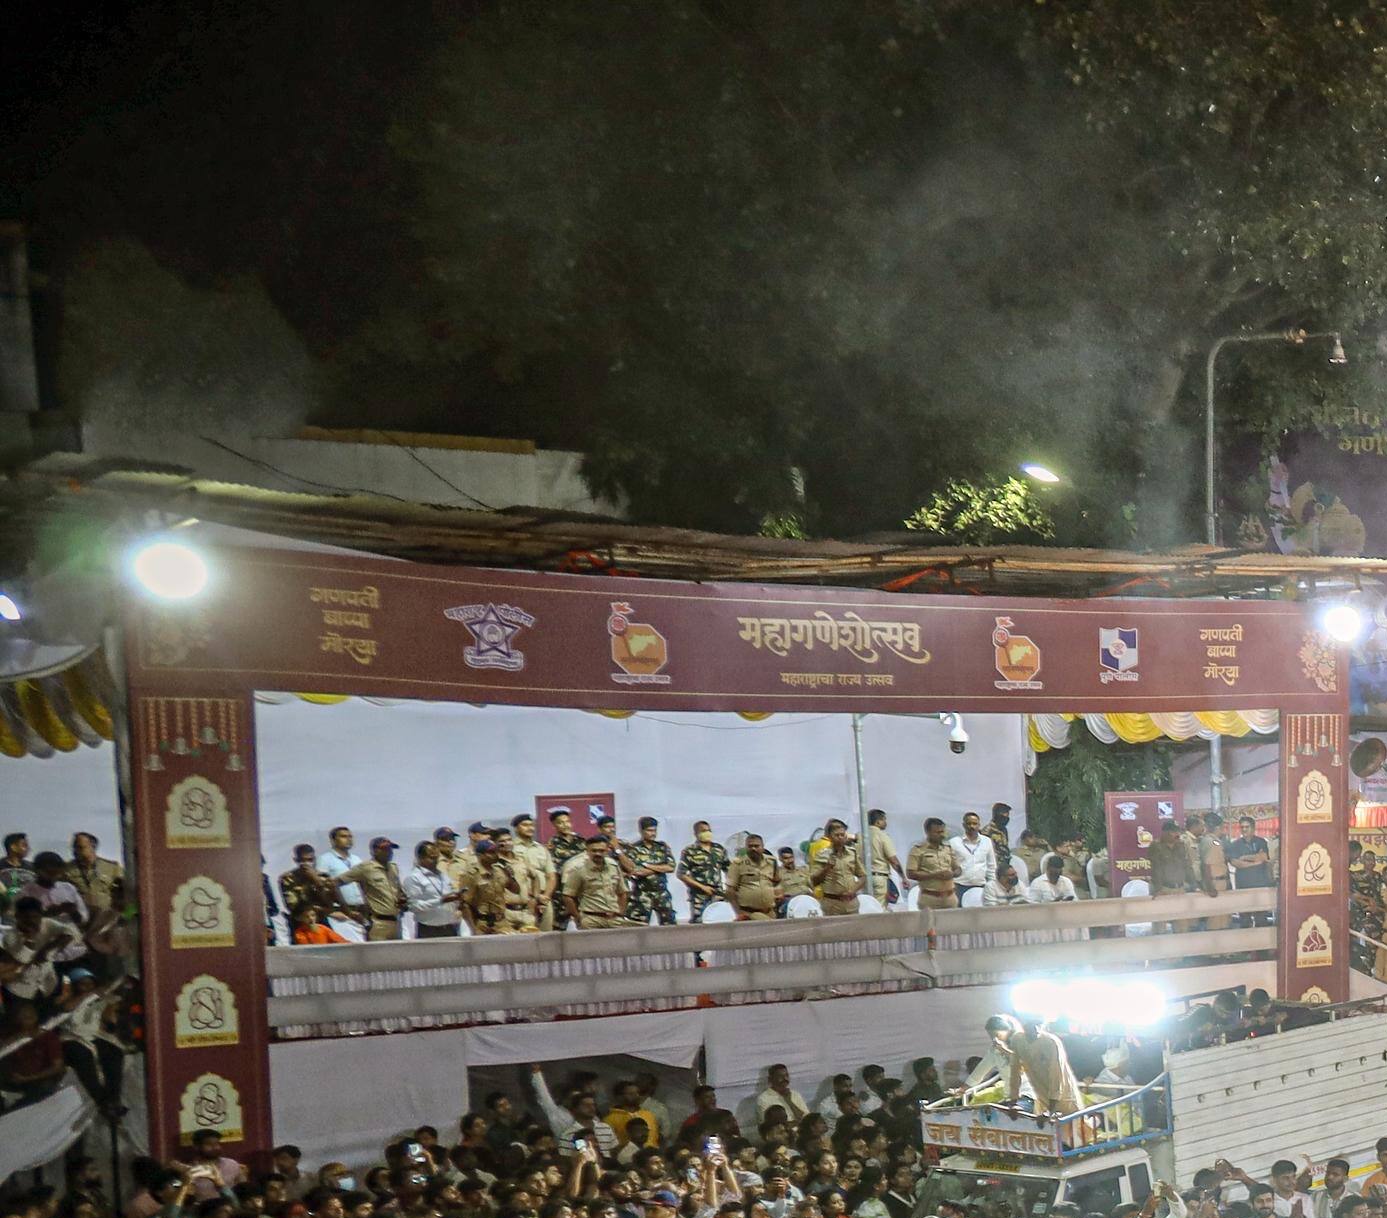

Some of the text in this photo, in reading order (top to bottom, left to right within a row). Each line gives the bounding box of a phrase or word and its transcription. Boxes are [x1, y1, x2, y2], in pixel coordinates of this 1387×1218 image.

[737, 611, 931, 665] महागणेशोत्सव
[1200, 623, 1243, 643] गणपती
[1207, 644, 1236, 659] बाप्पा
[837, 673, 861, 688] राज्य
[865, 673, 894, 687] उत्सव
[1203, 664, 1240, 686] मोरया
[926, 1123, 961, 1145] जय
